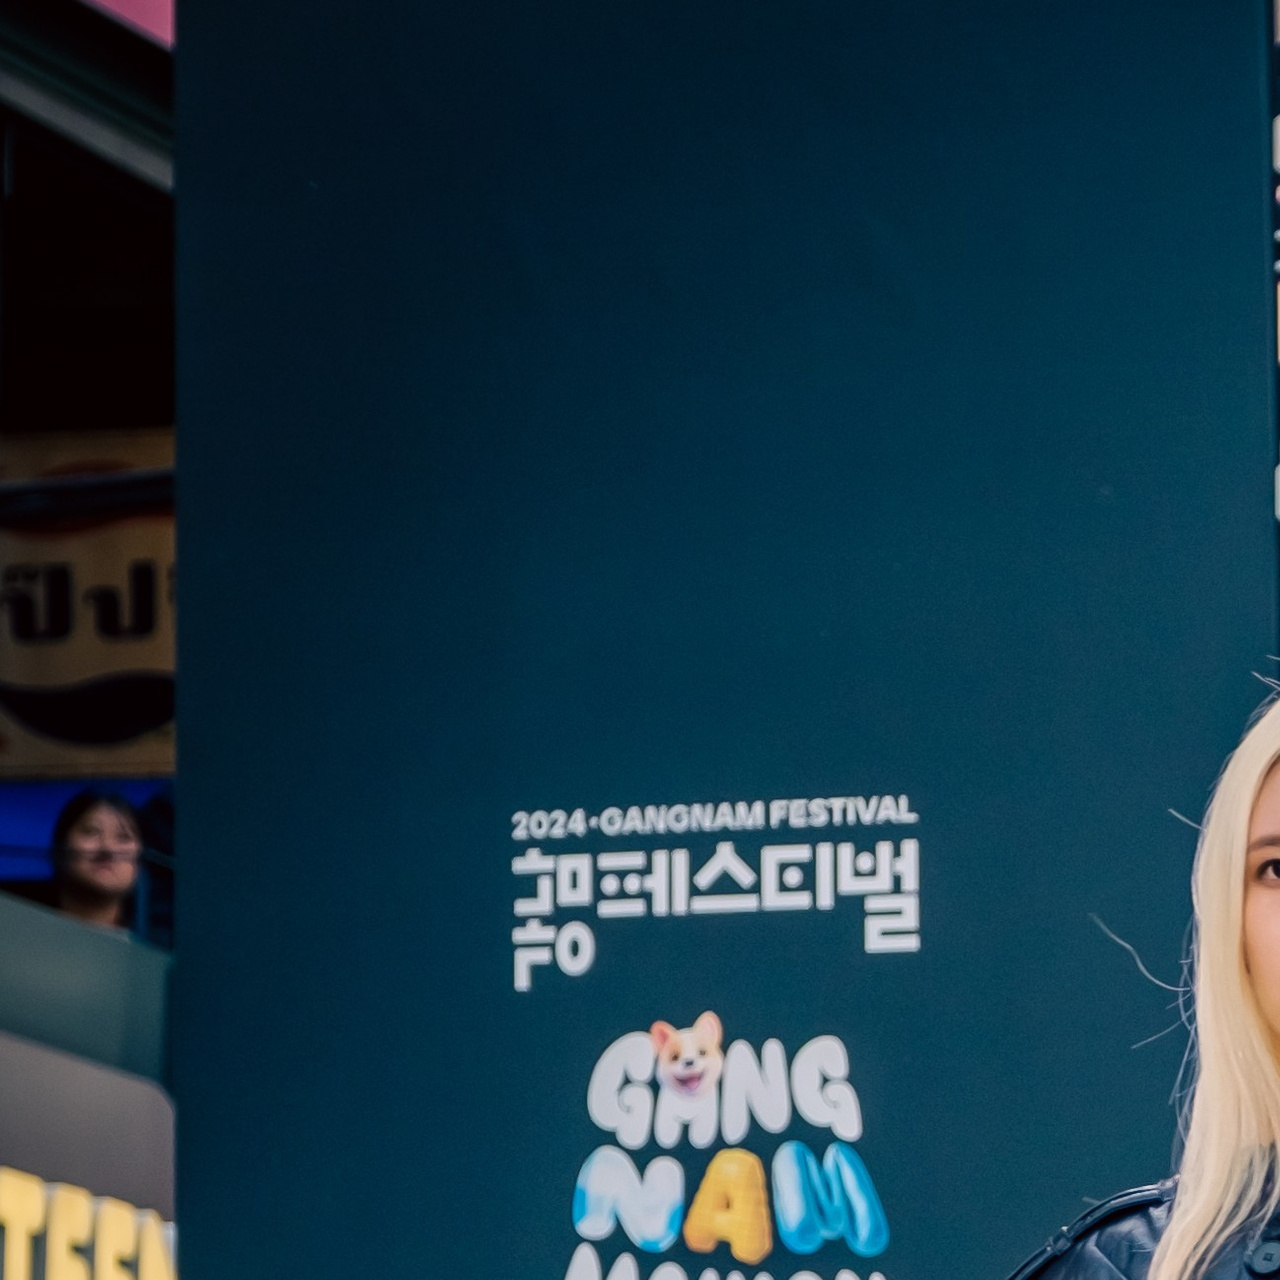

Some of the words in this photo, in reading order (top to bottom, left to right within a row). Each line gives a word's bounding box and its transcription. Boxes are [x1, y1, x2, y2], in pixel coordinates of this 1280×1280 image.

[769, 794, 920, 829] FESTIVAL
[587, 1024, 864, 1150] GANG
[572, 1139, 891, 1266] NAM
